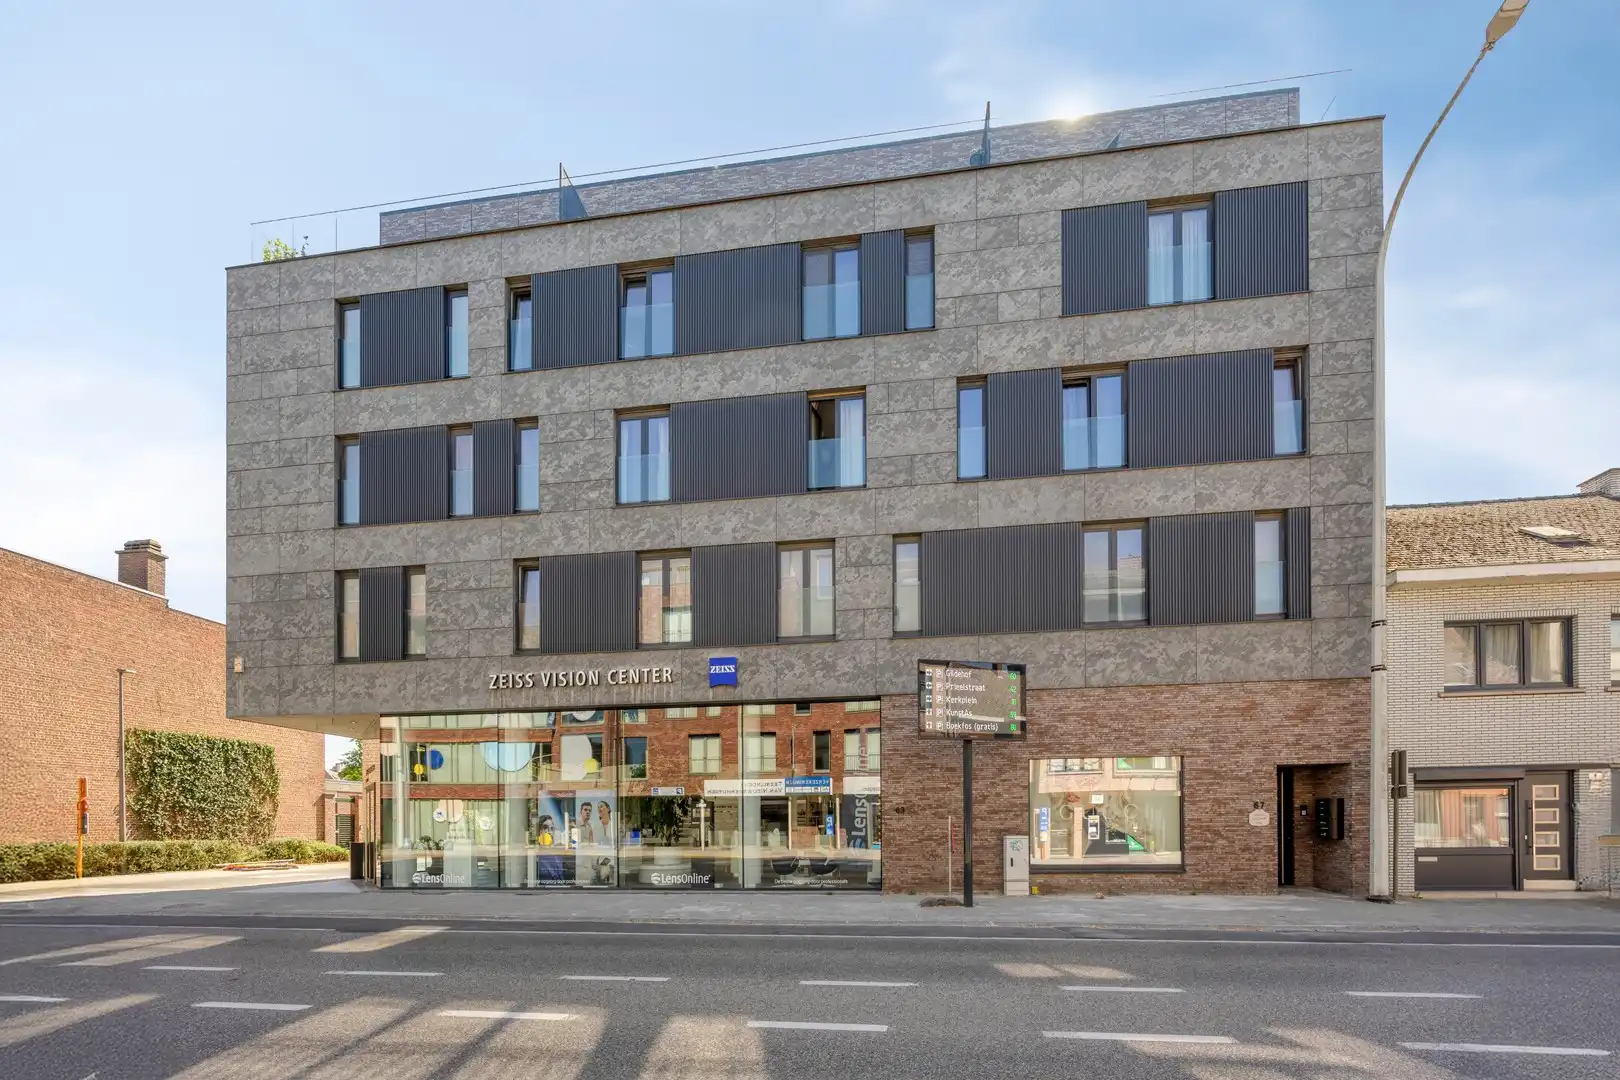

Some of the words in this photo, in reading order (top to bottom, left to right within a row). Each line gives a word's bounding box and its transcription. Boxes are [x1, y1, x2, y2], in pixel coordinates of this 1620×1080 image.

[710, 665, 735, 673] ZEISS
[488, 673, 534, 689] ZEISS
[541, 670, 600, 687] VISION
[607, 667, 673, 685] CENTER
[946, 696, 978, 705] Kerkplein
[421, 873, 465, 884] LensOnline
[661, 872, 710, 884] LensOnline
